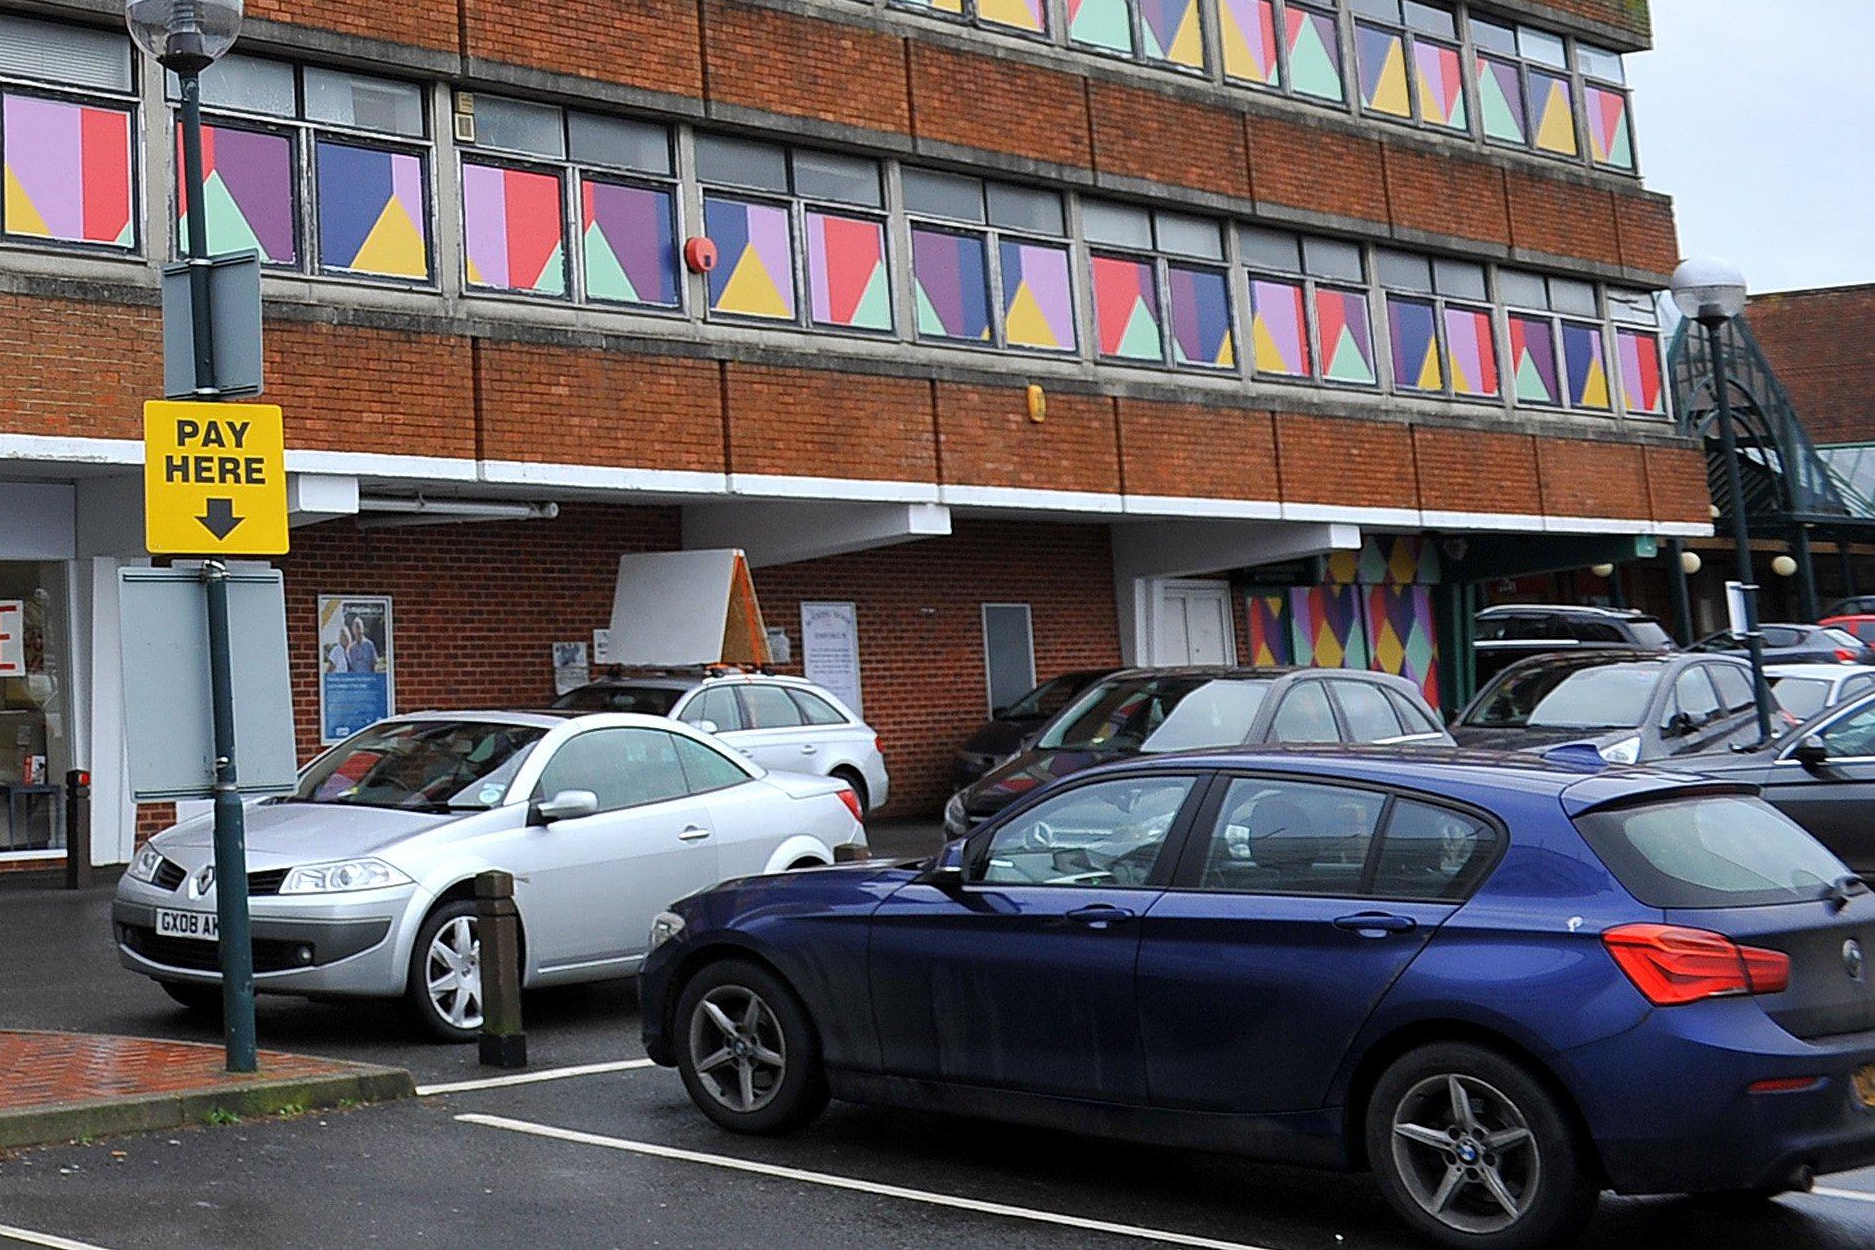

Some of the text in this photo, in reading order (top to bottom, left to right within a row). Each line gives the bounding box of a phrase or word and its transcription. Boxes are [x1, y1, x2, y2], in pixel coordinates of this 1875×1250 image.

[176, 419, 250, 448] PAY
[165, 455, 266, 484] HERE
[161, 911, 199, 934] GX08
